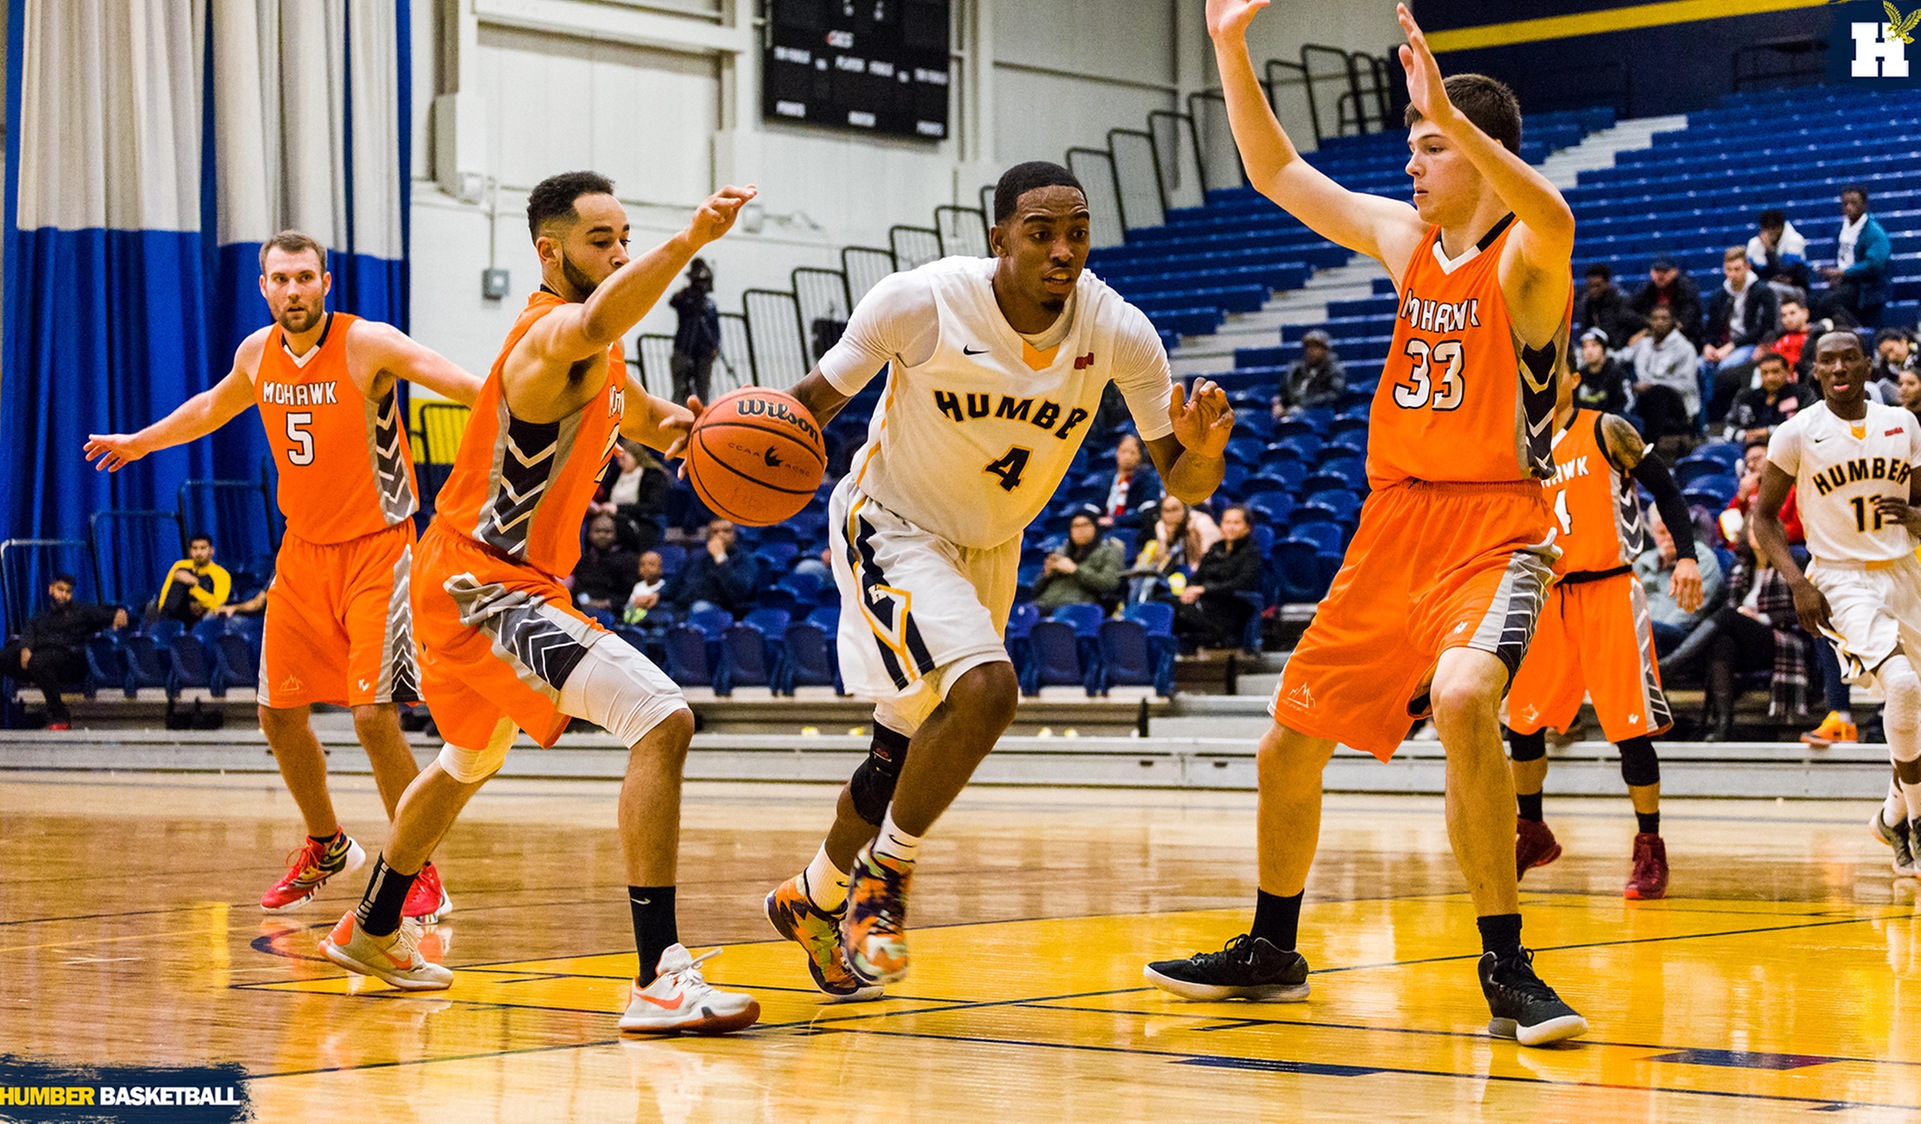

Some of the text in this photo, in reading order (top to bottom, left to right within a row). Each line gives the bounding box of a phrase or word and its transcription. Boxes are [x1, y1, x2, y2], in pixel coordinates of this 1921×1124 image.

[262, 381, 338, 406] MOHAWK
[1393, 338, 1465, 411] 33
[286, 411, 315, 466] 5
[736, 398, 821, 447] Wilson
[981, 444, 1034, 494] 4
[1811, 457, 1912, 497] HUMBER
[1849, 493, 1883, 533] 11
